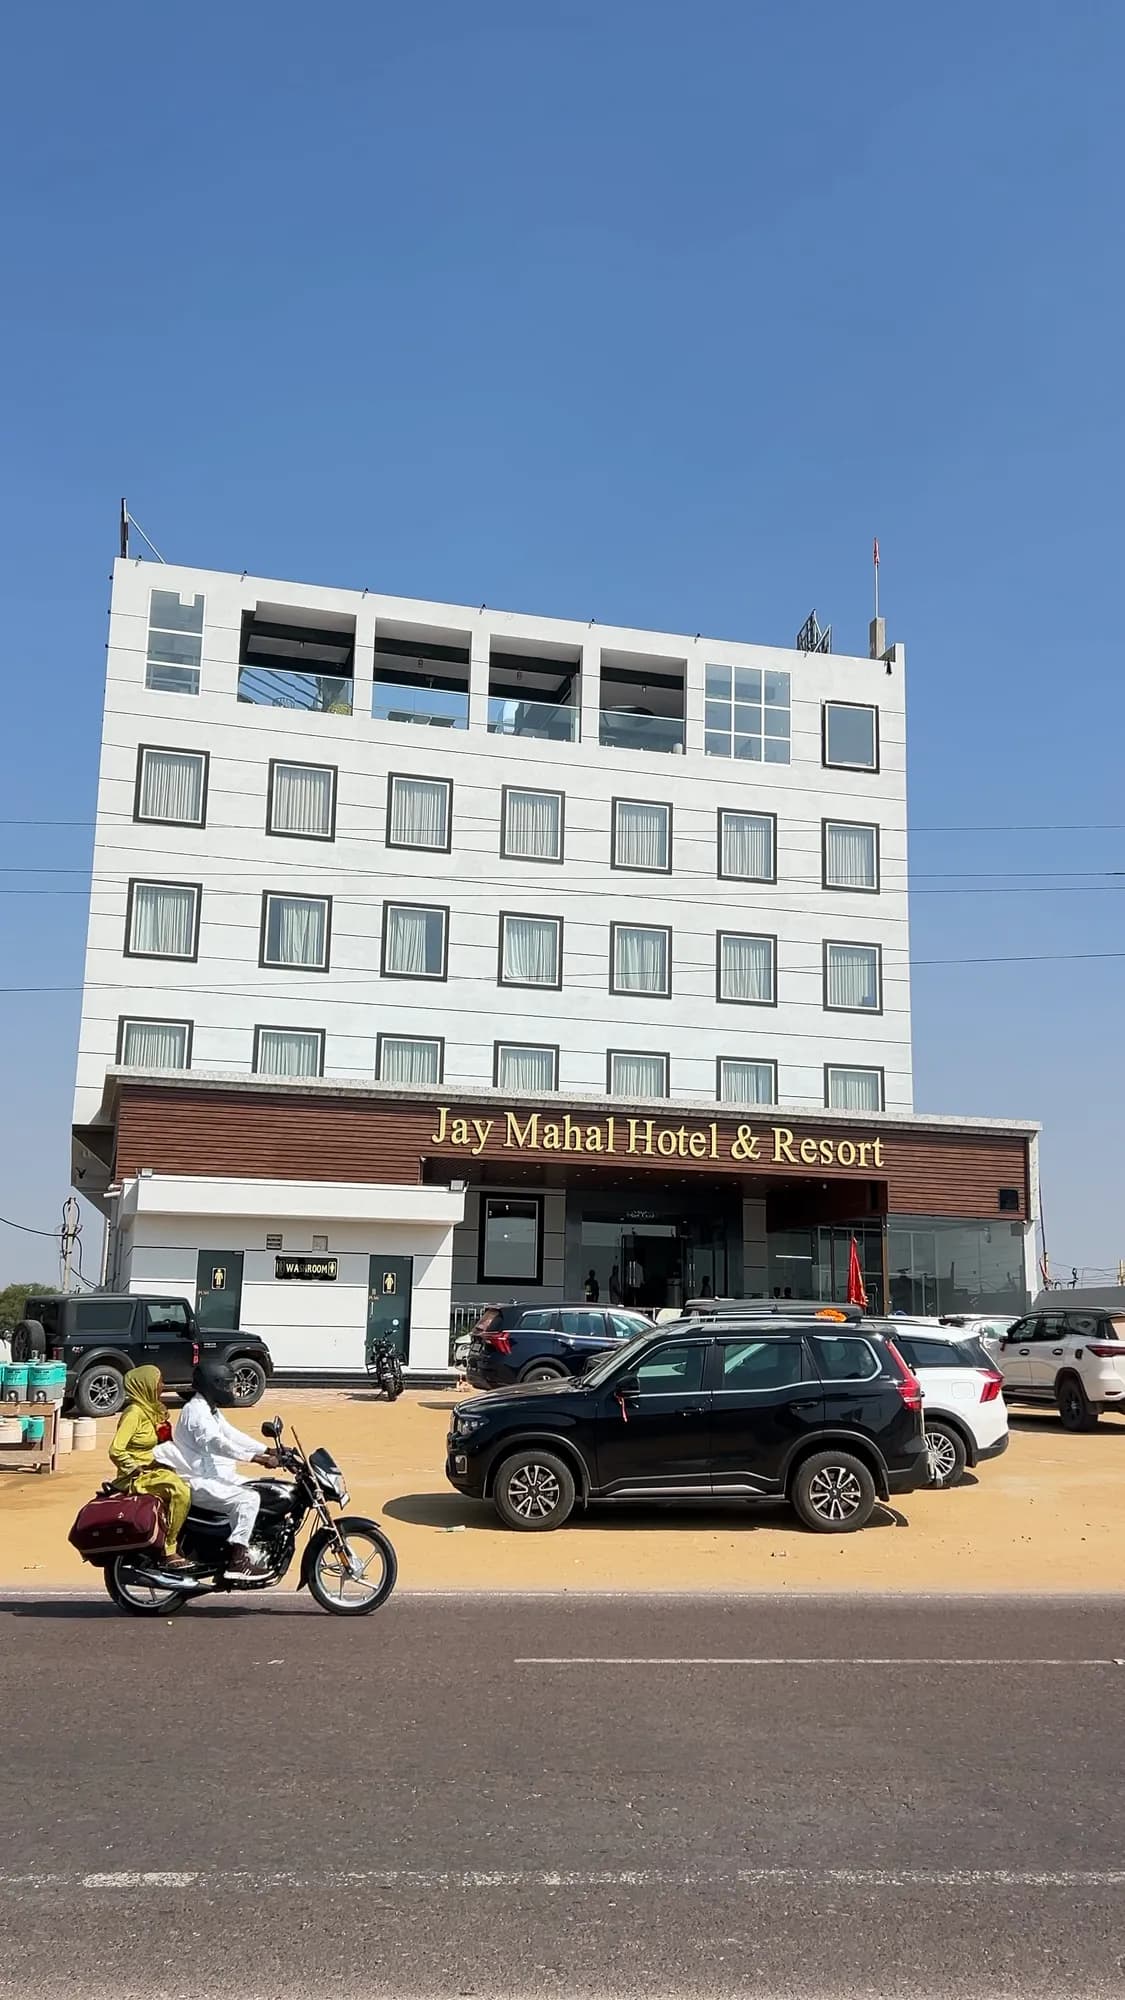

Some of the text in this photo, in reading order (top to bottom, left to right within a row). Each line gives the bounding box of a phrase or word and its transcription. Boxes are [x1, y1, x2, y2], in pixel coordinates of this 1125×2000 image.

[431, 1107, 884, 1167] Jay Mahal Hotel & Resort
